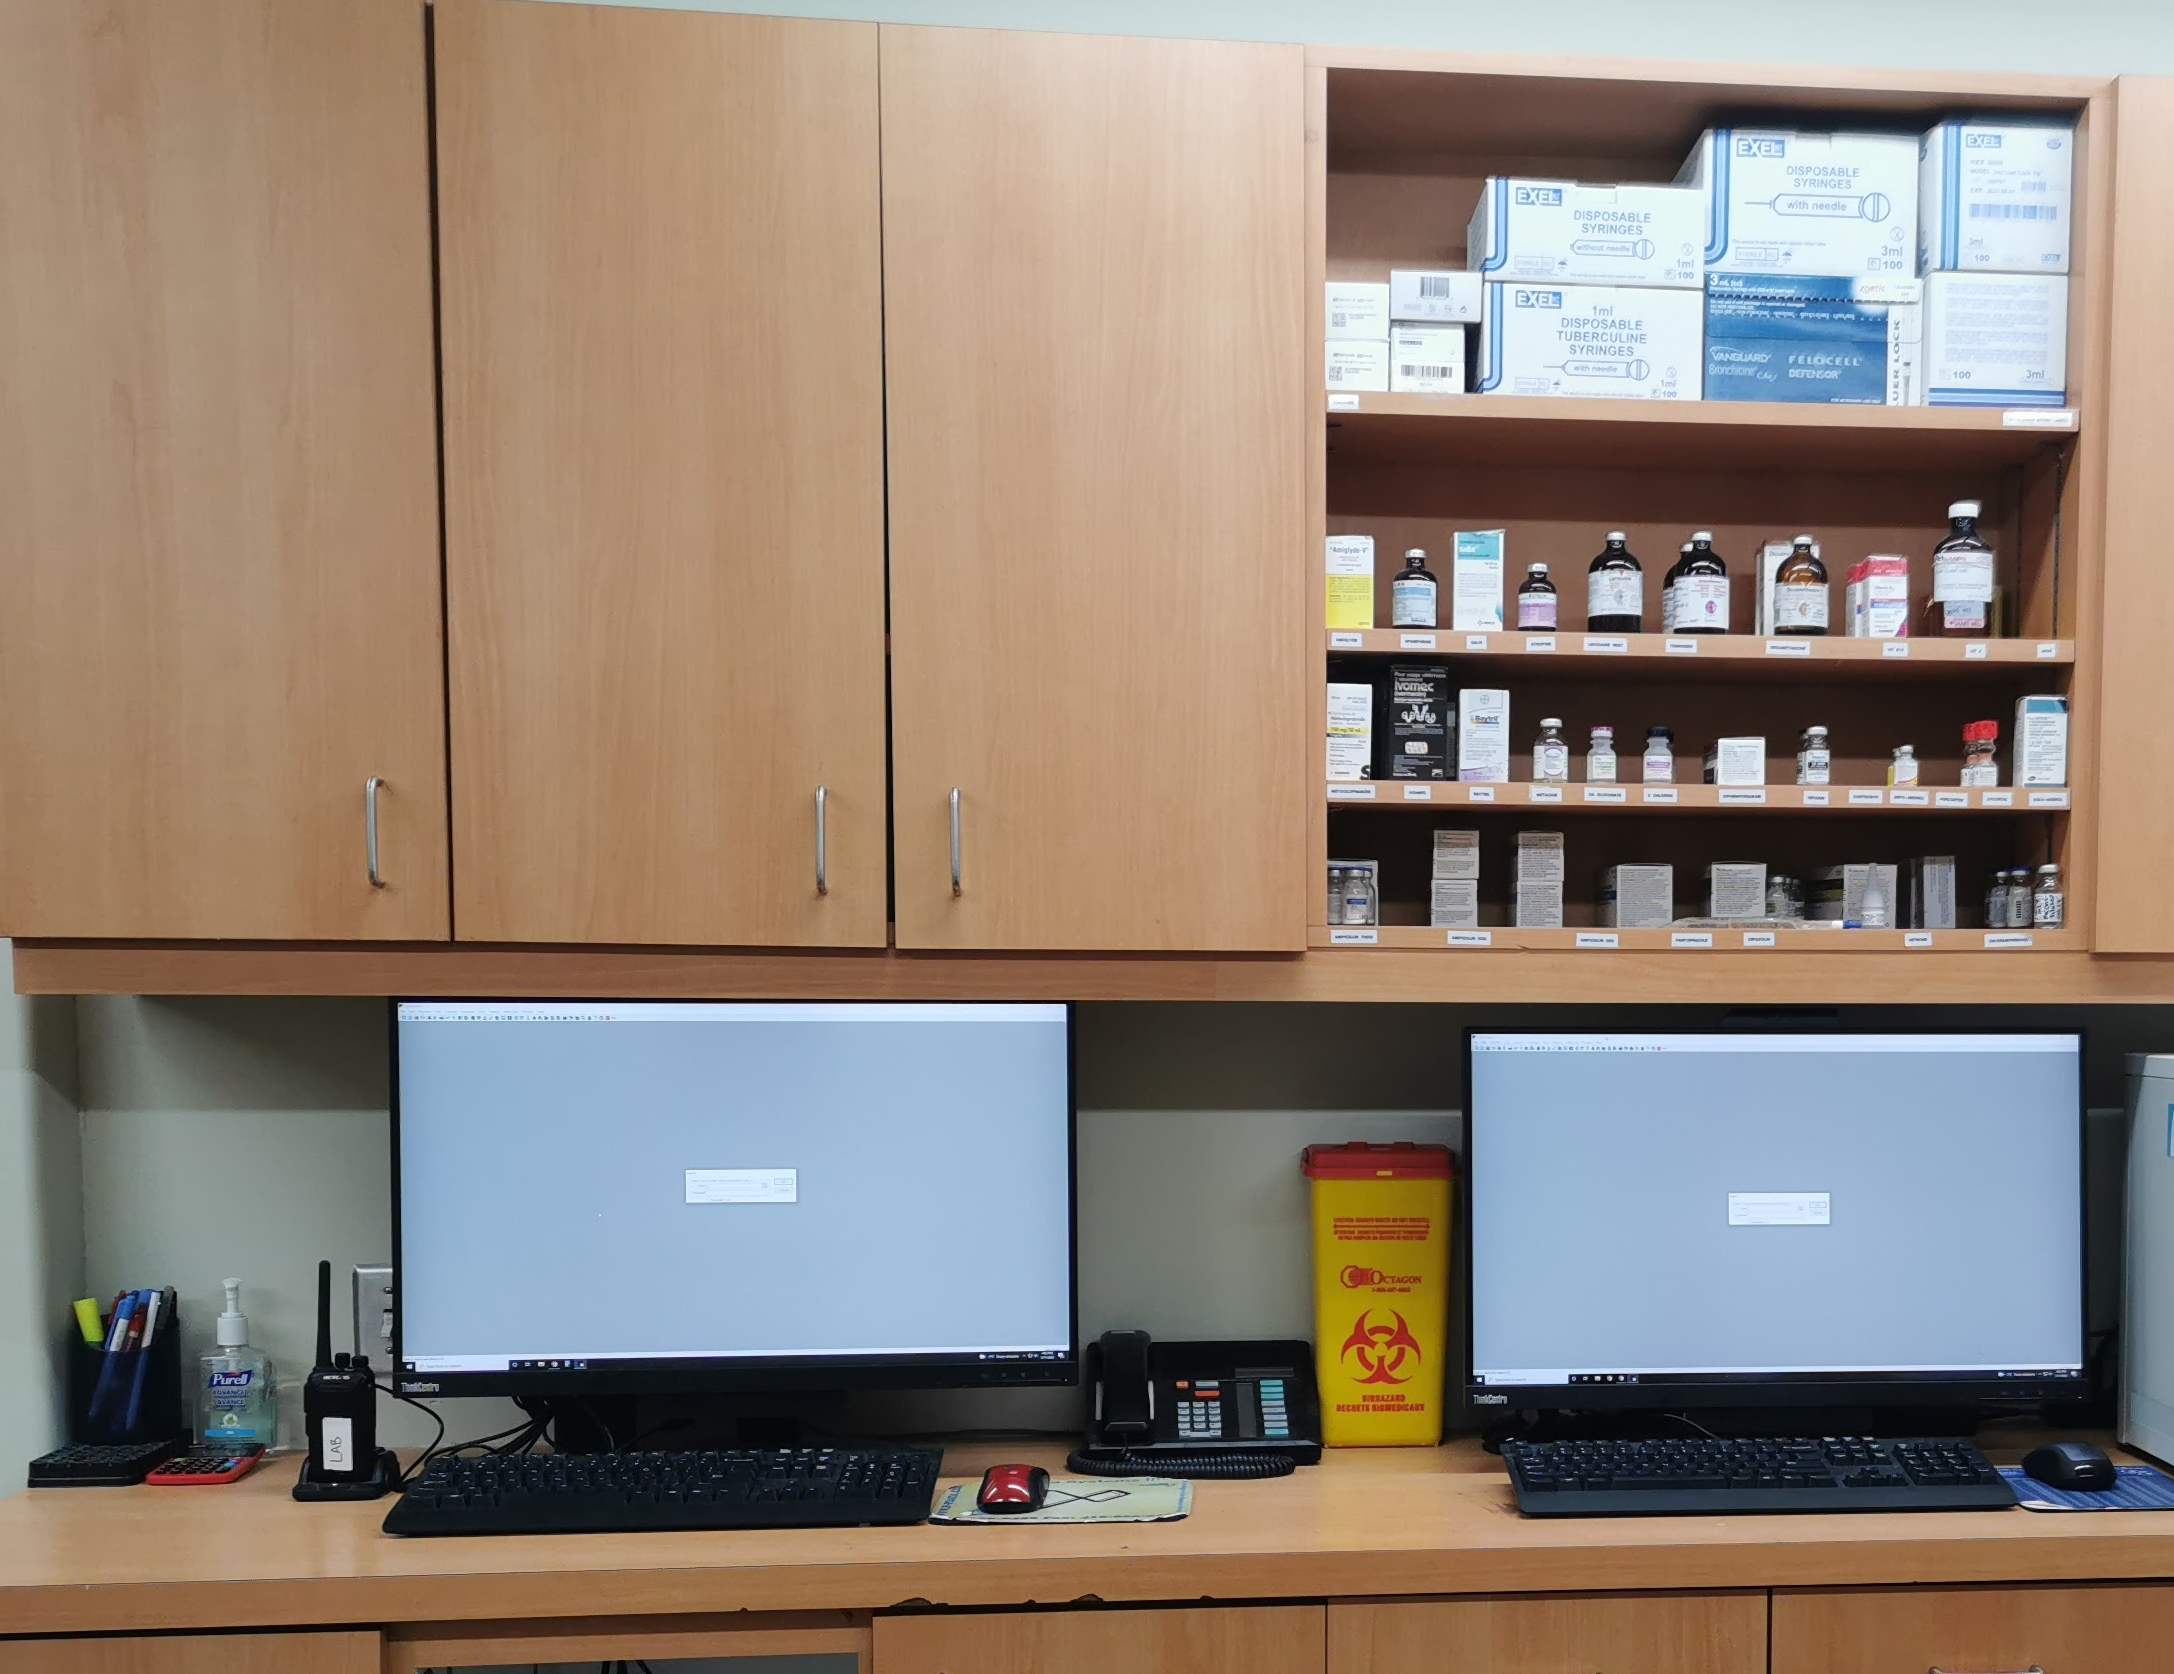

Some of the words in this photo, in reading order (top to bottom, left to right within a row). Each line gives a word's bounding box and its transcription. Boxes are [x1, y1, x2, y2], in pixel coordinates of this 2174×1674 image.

[1966, 134, 2002, 148] EXEL
[1737, 138, 1785, 158] EXEL
[1786, 166, 1860, 178] DISPOSABLE
[1794, 178, 1852, 189] SYRINGES
[1516, 187, 1562, 206] EXEL
[1786, 200, 1809, 210] with
[1811, 201, 1847, 212] needle
[1573, 210, 1652, 223] DISPOSABLE
[1581, 223, 1644, 235] SYRINGES
[1576, 243, 1604, 251] without
[1881, 245, 1903, 257] 3ml
[1676, 259, 1694, 269] 1ml
[1974, 254, 1990, 262] 100
[1882, 260, 1903, 270] 100
[1677, 271, 1694, 279] 100
[1709, 274, 1719, 286] 3
[1515, 290, 1562, 309] EXEL
[1592, 306, 1613, 317] 1ml
[1560, 317, 1643, 330] DISPOSABLE
[1556, 330, 1647, 344] TUBERCULINE
[1892, 319, 1901, 362] LOCK
[1568, 344, 1634, 357] SYRINGES
[1711, 351, 1771, 363] VANGUARD
[1788, 354, 1862, 367] FELOCELL
[1573, 364, 1590, 372] with
[2025, 368, 2045, 380] 3ml
[1953, 370, 1971, 380] 100
[1660, 379, 1676, 387] 1ml
[212, 1373, 249, 1386] Purell
[329, 1436, 343, 1463] LAB
